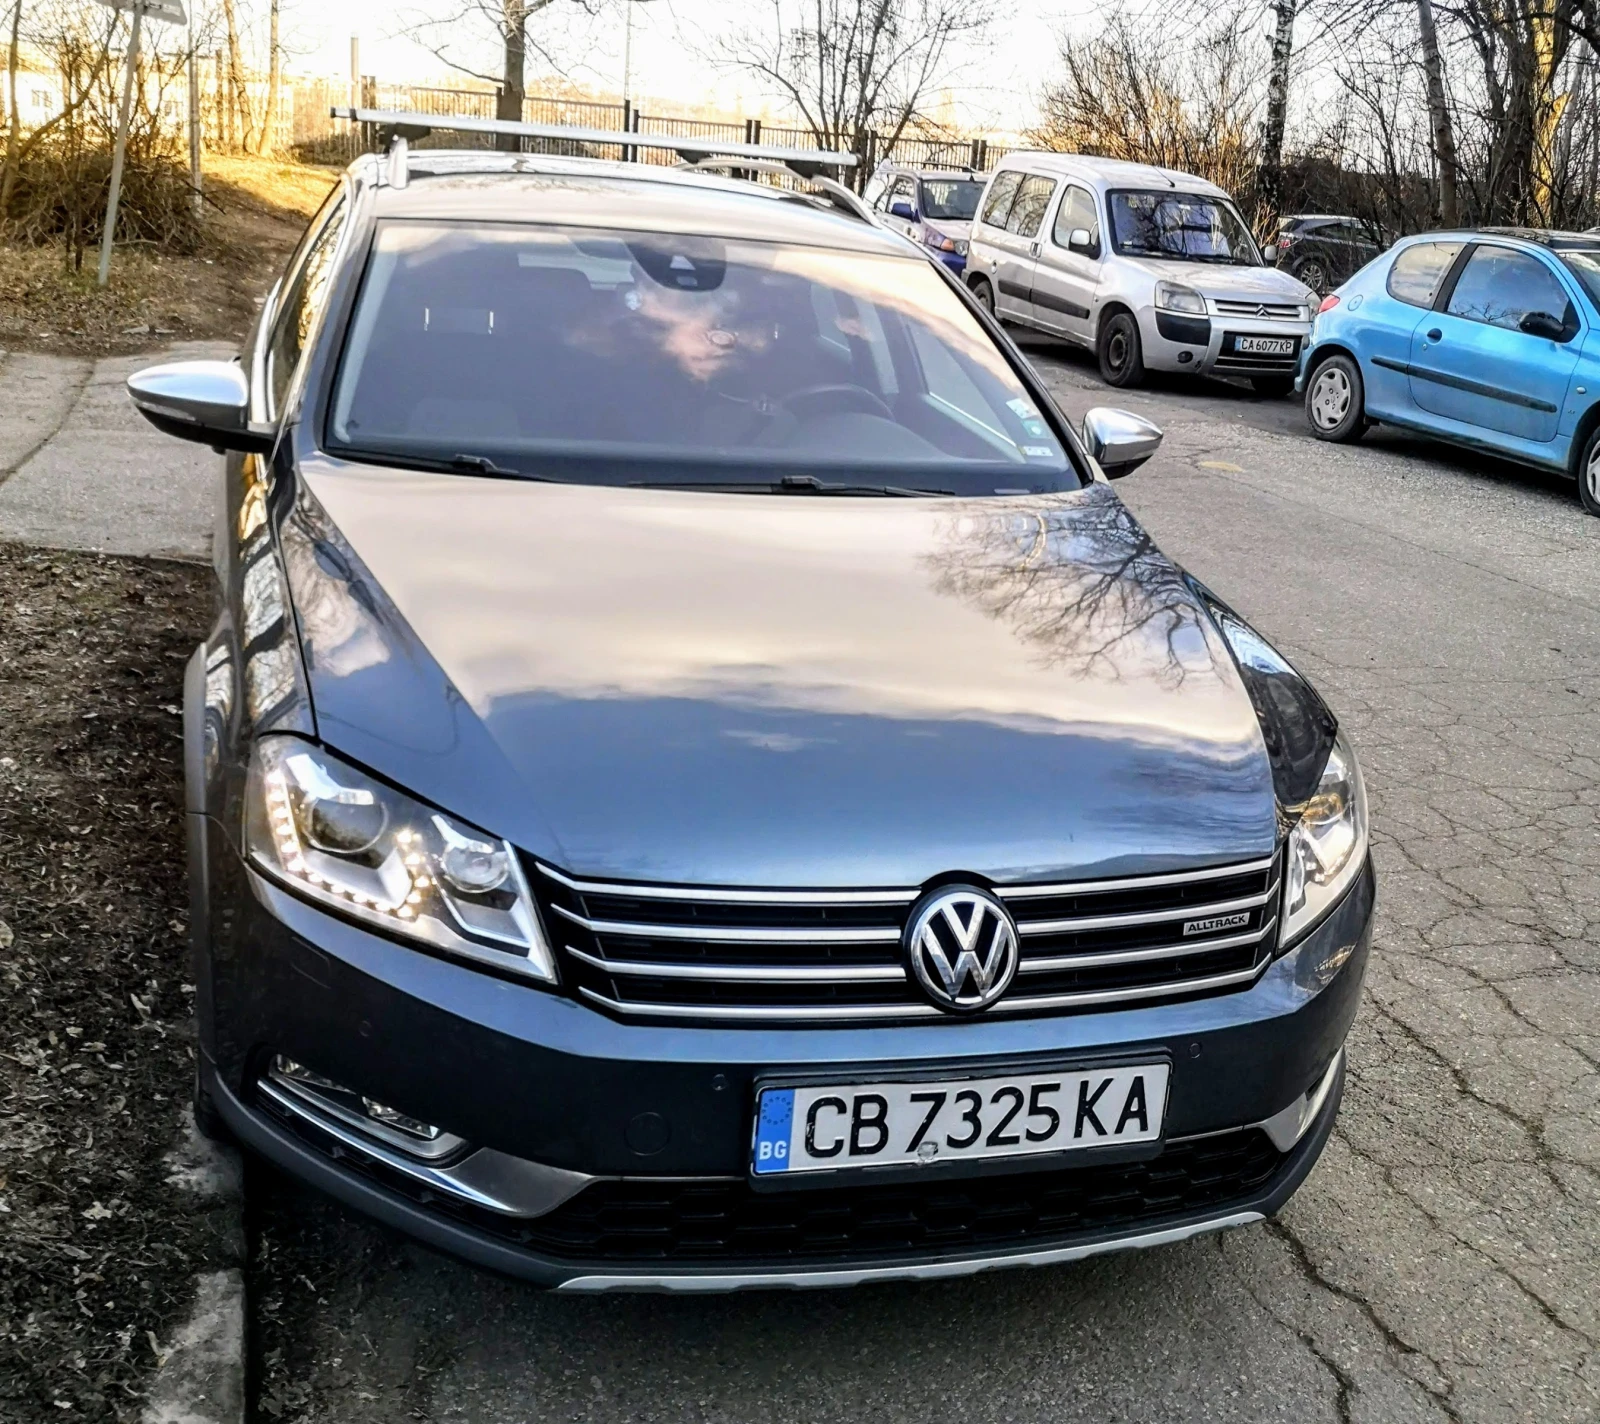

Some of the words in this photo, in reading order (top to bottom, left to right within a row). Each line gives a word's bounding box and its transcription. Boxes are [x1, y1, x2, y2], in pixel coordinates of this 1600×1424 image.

[1241, 339, 1254, 351] CA
[1256, 340, 1279, 352] 6077
[1280, 340, 1292, 352] KP
[1187, 914, 1246, 932] ALLTRACK
[805, 1094, 889, 1158] CB
[905, 1082, 1061, 1153] 7325
[1073, 1075, 1148, 1138] KA
[759, 1141, 787, 1160] BG
